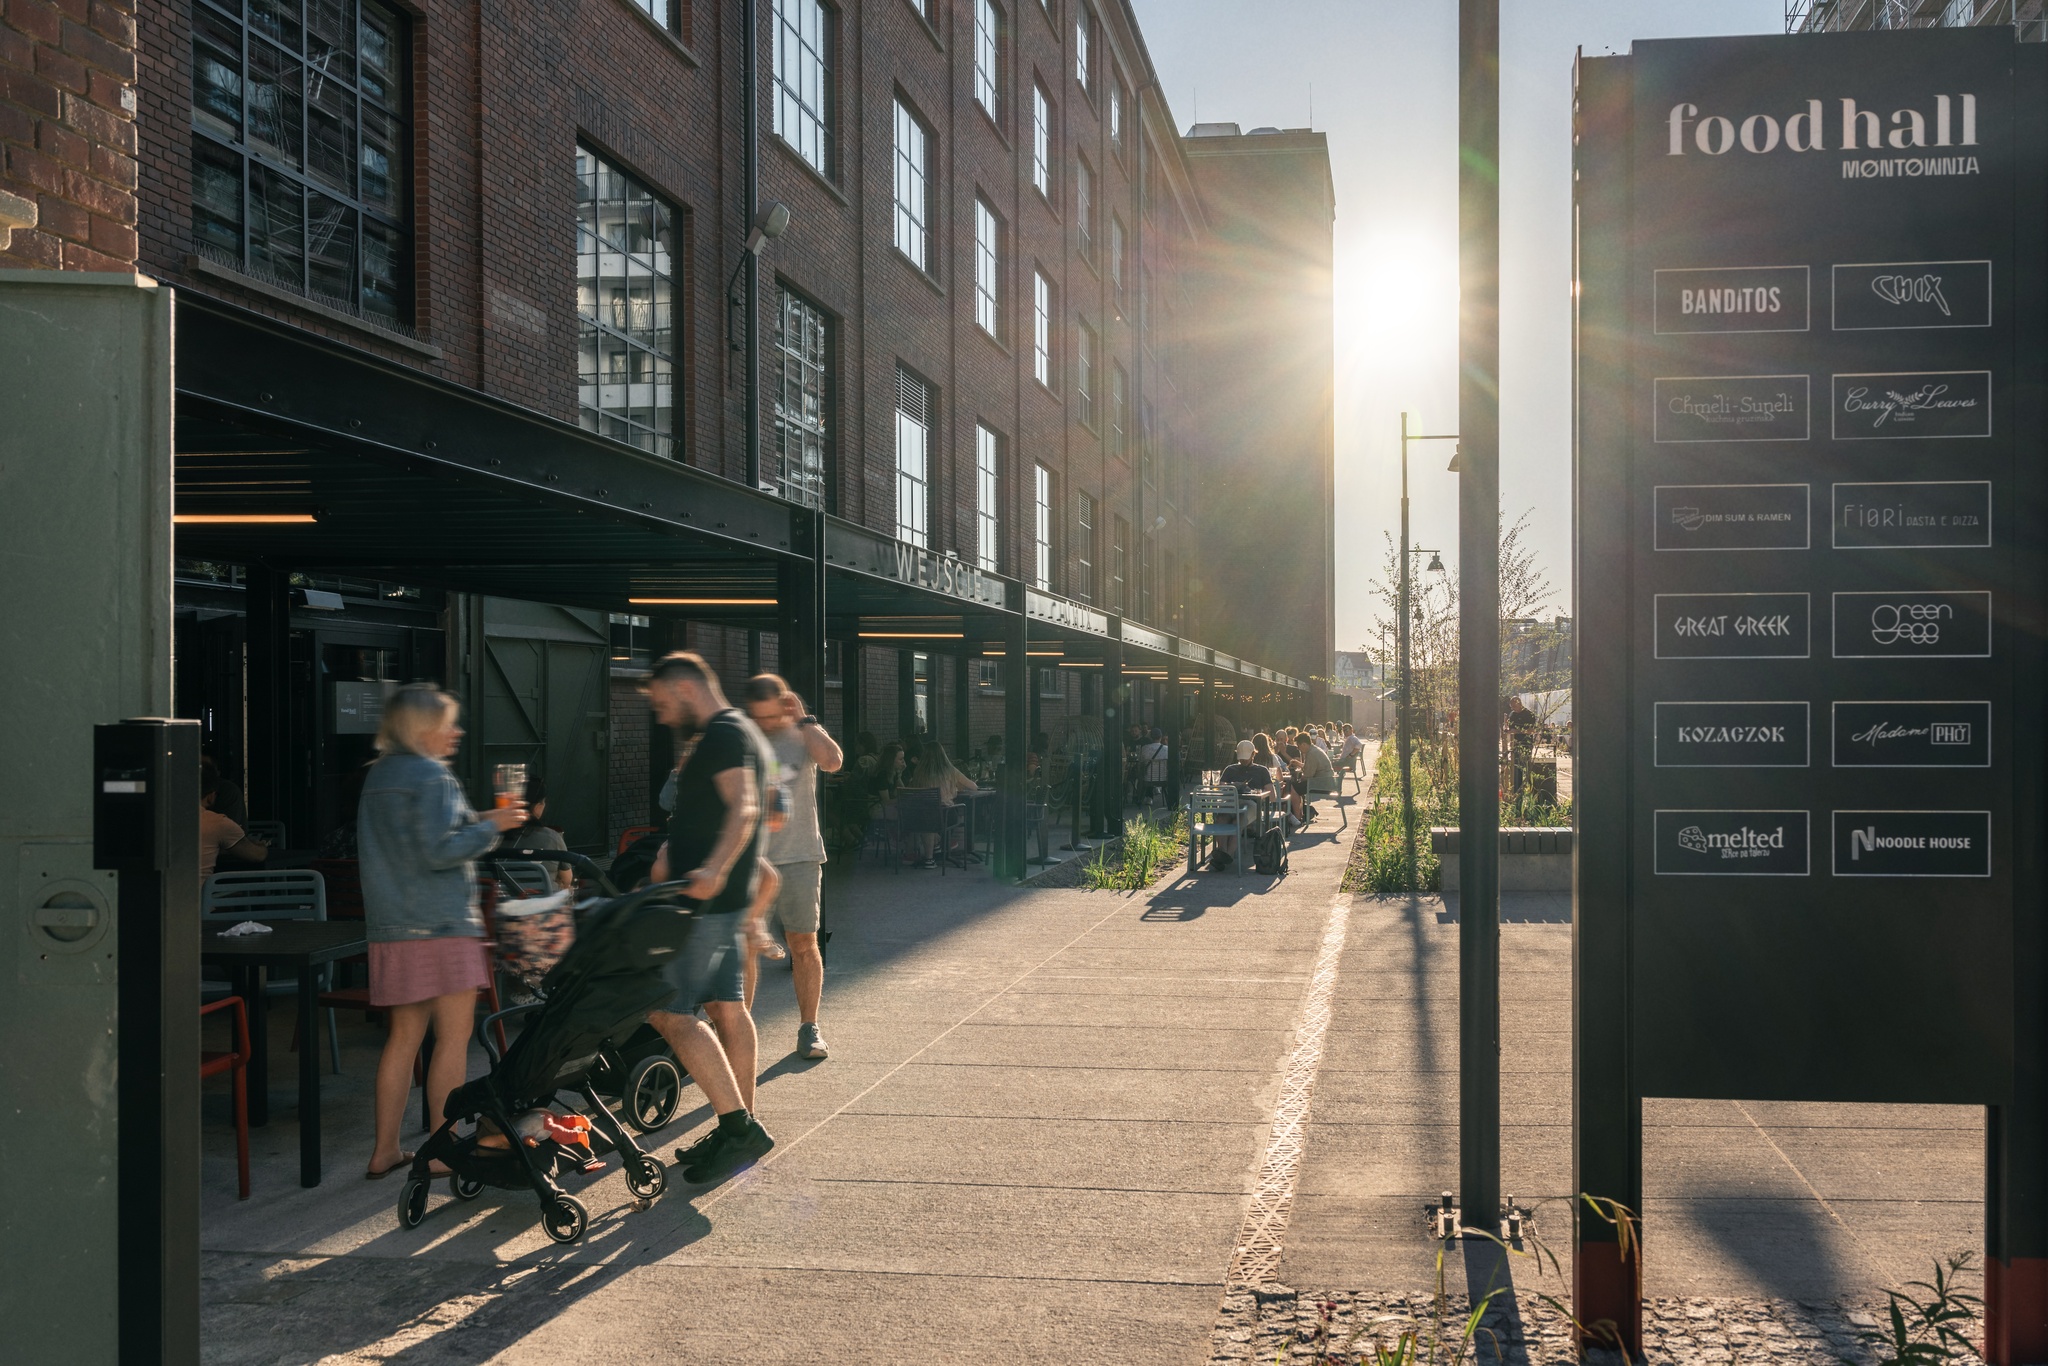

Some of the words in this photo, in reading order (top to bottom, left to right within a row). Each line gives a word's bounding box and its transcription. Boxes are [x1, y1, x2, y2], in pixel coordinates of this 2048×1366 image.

[1665, 99, 1825, 156] food
[1839, 93, 1980, 150] hall
[1681, 287, 1781, 314] BANDITOS
[1843, 386, 1898, 428] Curry
[1909, 384, 1978, 410] Leaves
[1705, 414, 1735, 423] kuchnia
[1705, 514, 1723, 522] DIM
[1725, 513, 1745, 522] SUM
[1747, 513, 1755, 521] &
[1757, 513, 1792, 521] RAMEN
[1941, 516, 1948, 526] E
[1952, 515, 1980, 526] PIZZA
[1674, 616, 1729, 637] GREAT
[1734, 614, 1791, 636] GREEK
[1872, 604, 1953, 645] green
[1851, 722, 1930, 747] Madame
[1707, 826, 1785, 848] melted
[1876, 837, 1926, 848] NOODLE
[1929, 837, 1972, 849] HOUSE
